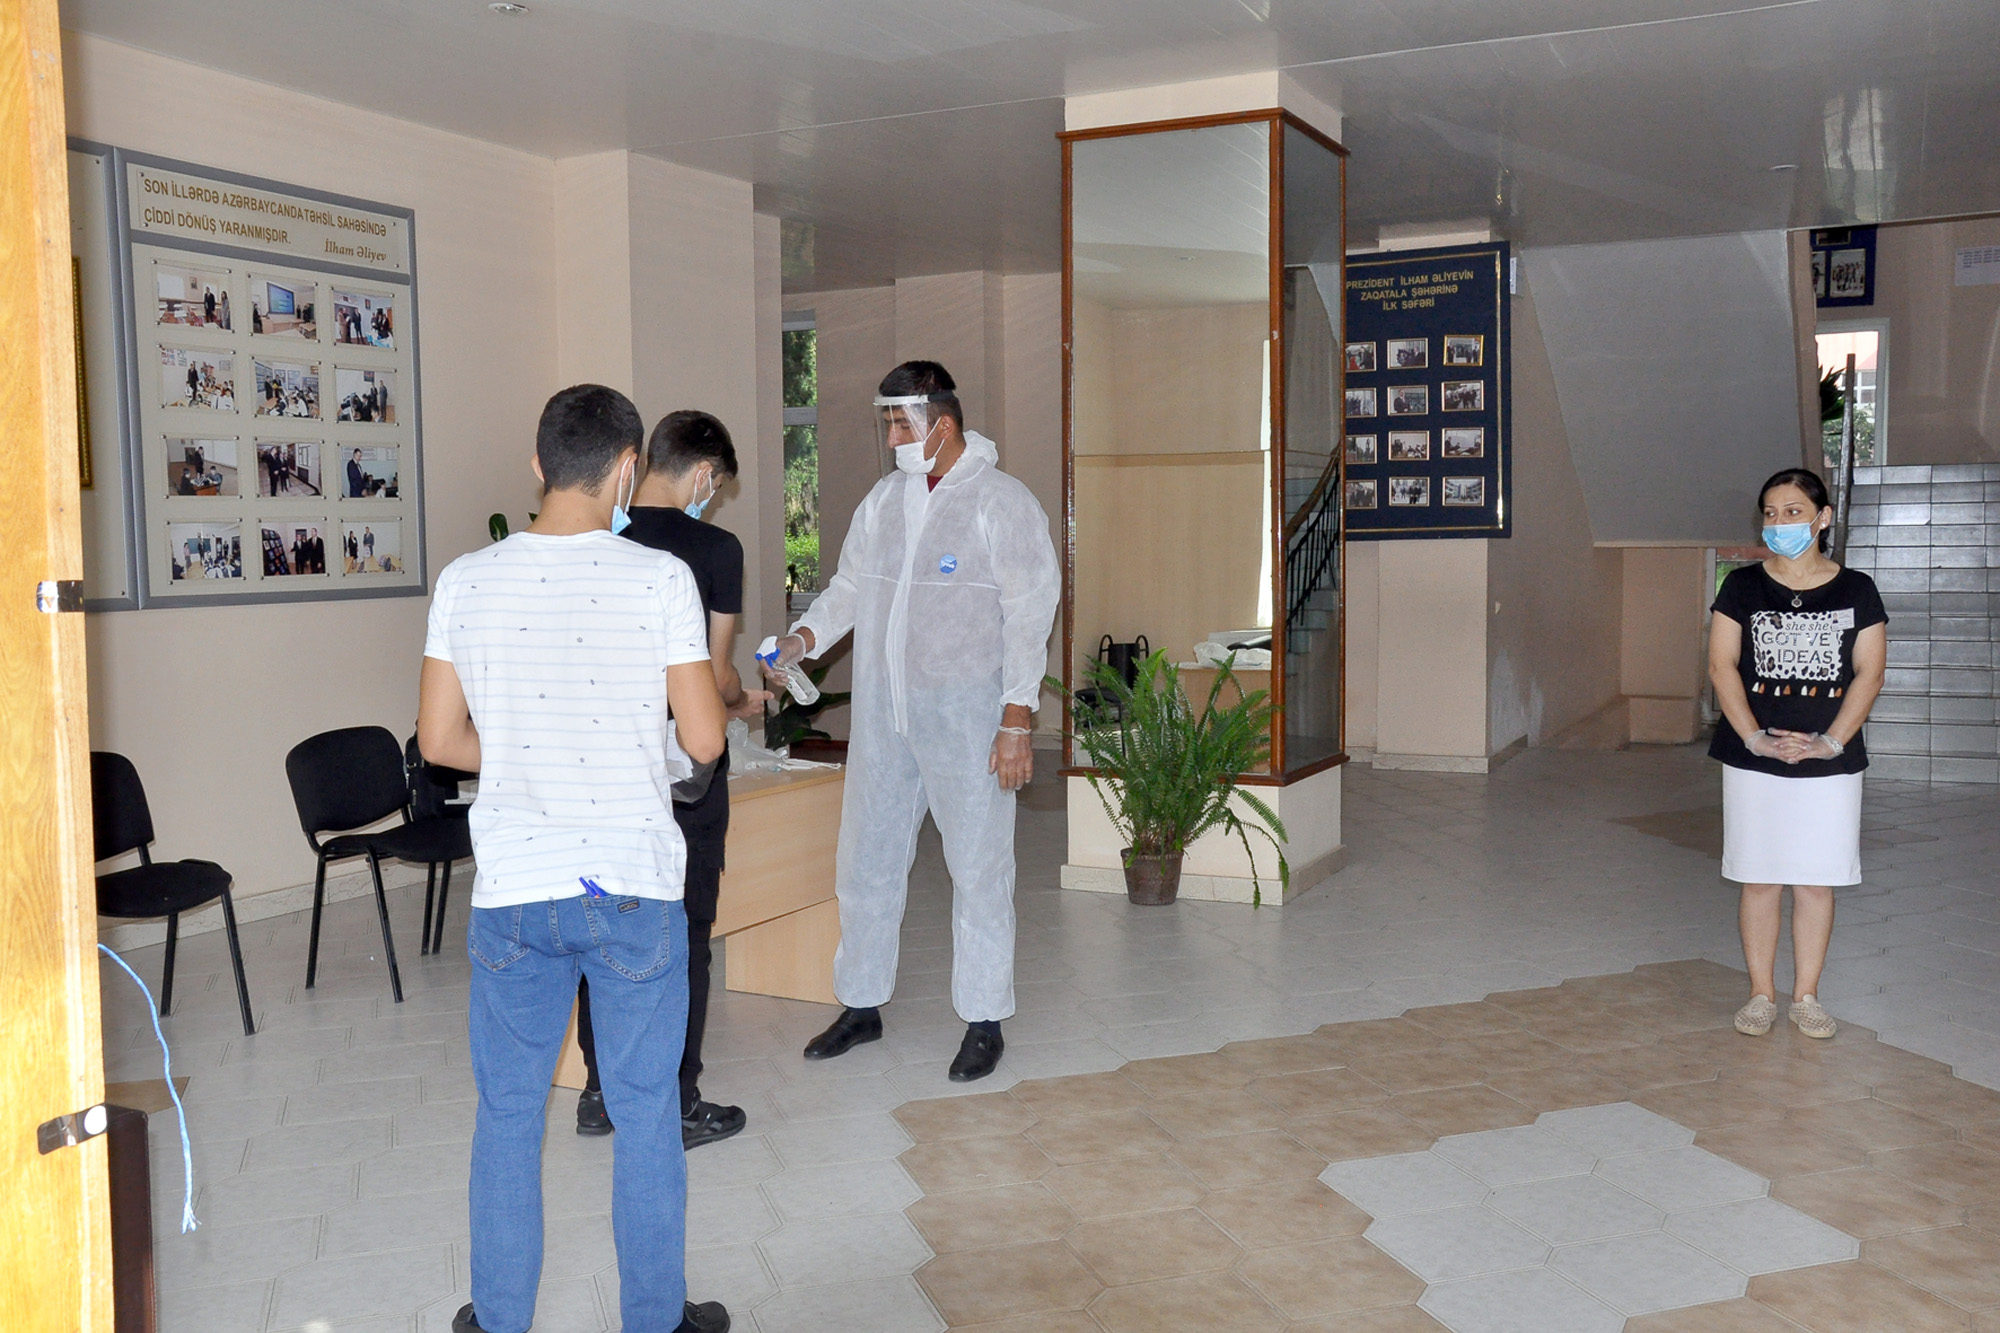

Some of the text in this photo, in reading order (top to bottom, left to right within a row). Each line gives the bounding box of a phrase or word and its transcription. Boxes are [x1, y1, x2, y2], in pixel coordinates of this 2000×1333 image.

[144, 179, 168, 195] SON
[171, 181, 219, 204] İLLƏRDƏ
[337, 216, 387, 236] SAHƏSİNDƏ
[178, 212, 217, 234] DÖNÜŞ
[219, 220, 291, 244] YARANMIŞDIR.
[325, 238, 387, 262] İlham Əliyev
[1346, 269, 1474, 289] PREZİDENT İLHAM ƏLİYEVİN
[1361, 284, 1458, 301] ZAQATALA ŞƏHƏRİNƏ
[1383, 297, 1435, 310] İLK SƏFƏRİ
[1778, 649, 1833, 664] IDEAS
